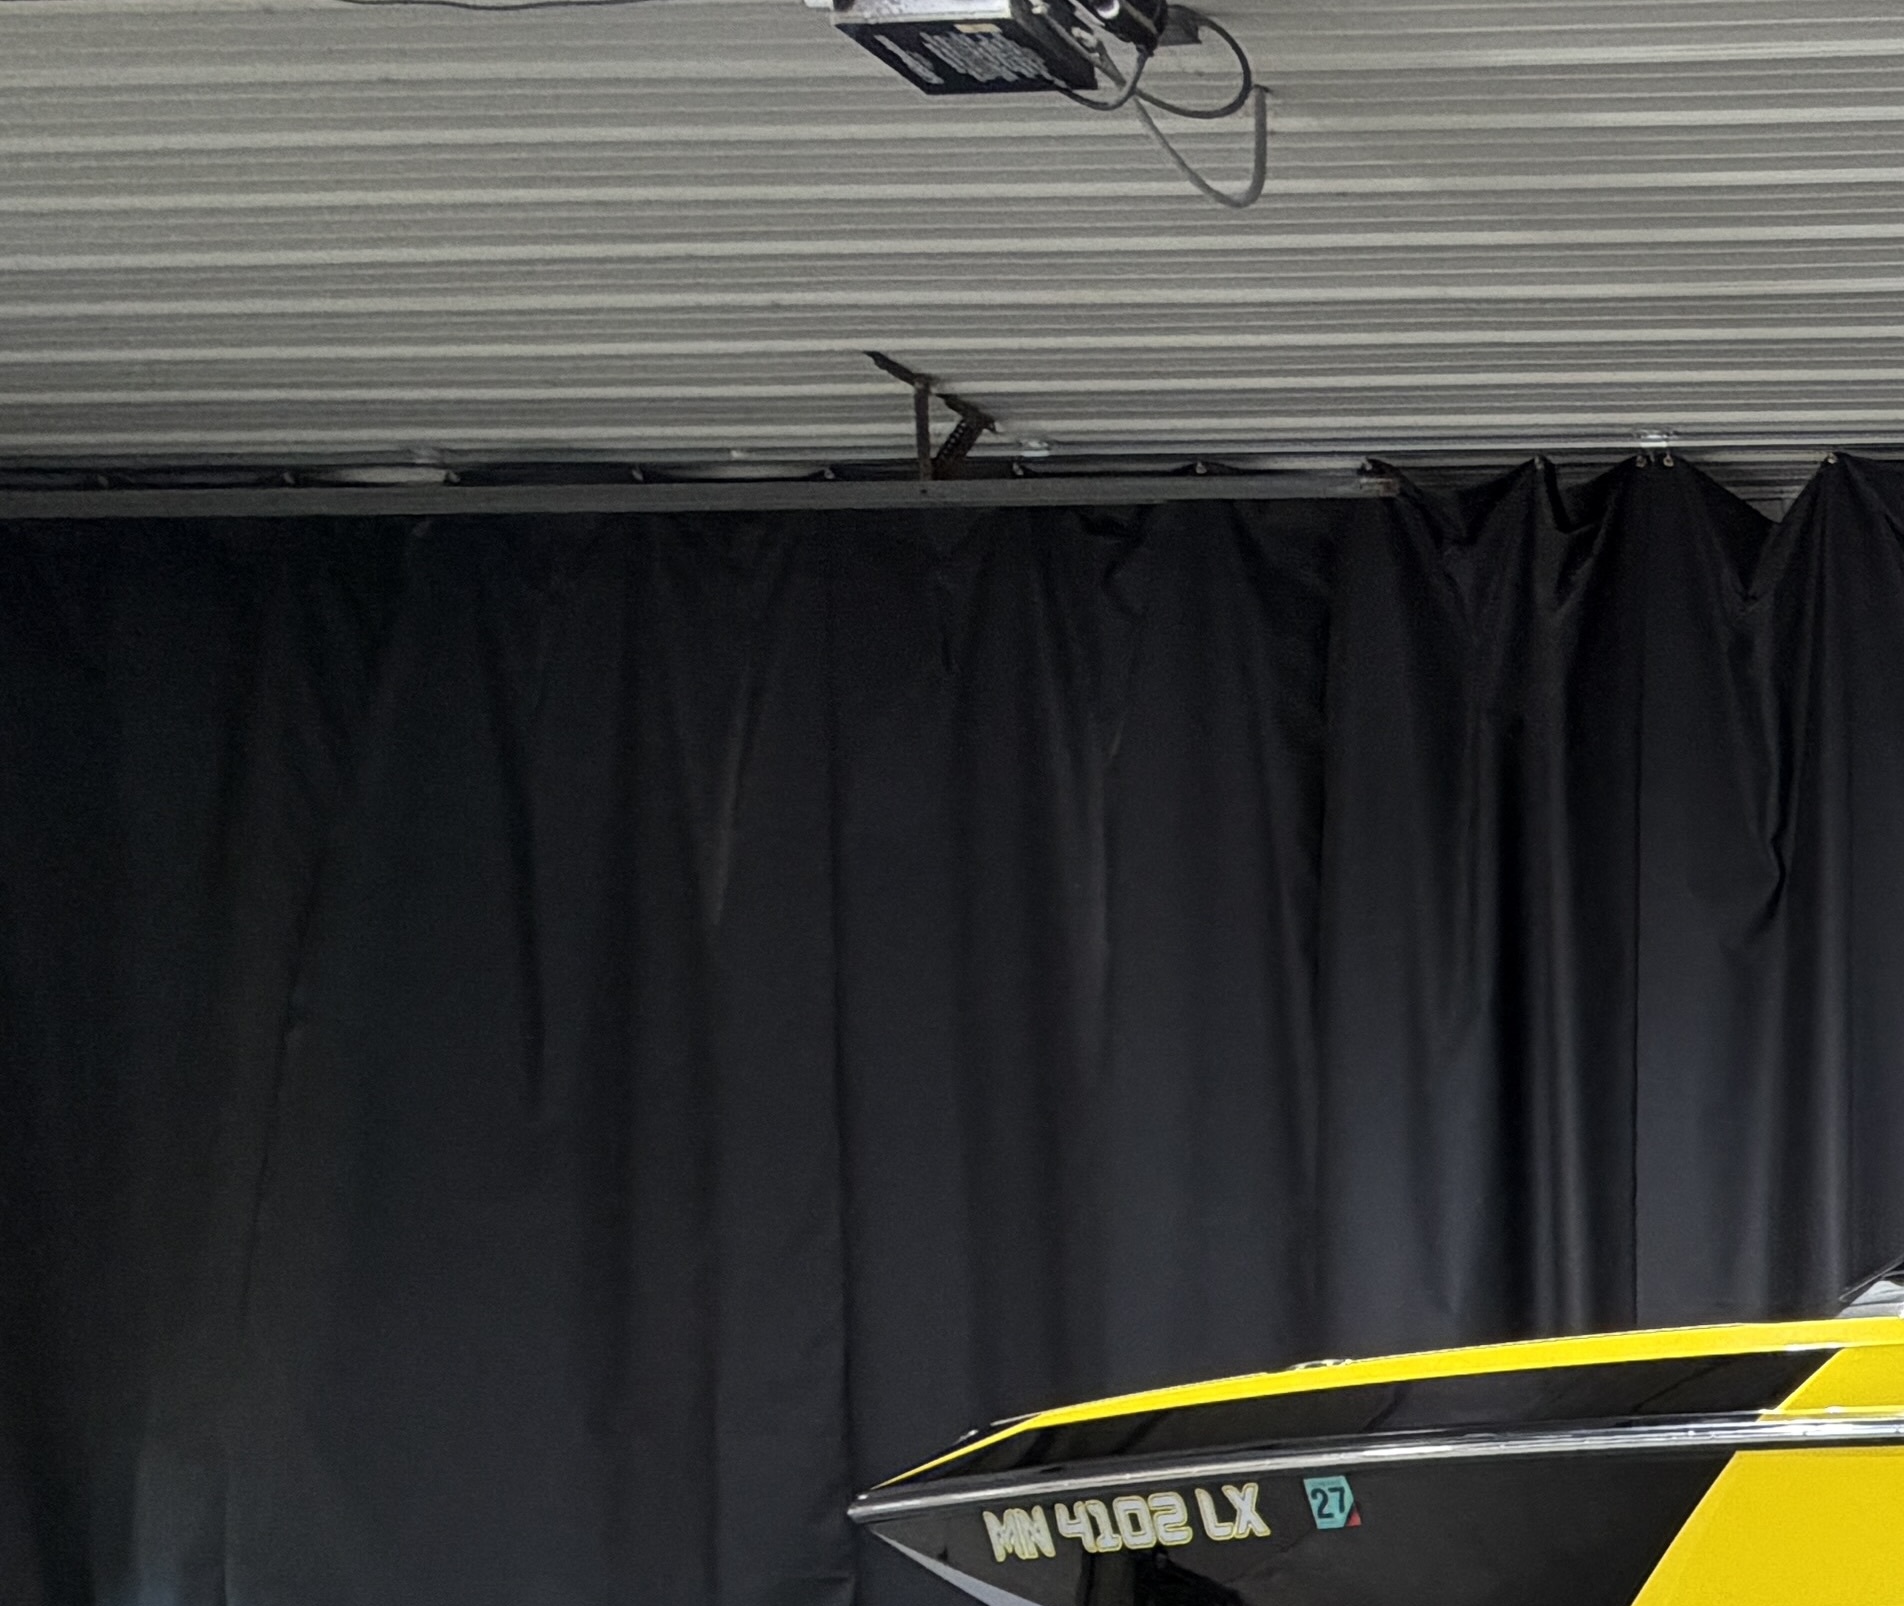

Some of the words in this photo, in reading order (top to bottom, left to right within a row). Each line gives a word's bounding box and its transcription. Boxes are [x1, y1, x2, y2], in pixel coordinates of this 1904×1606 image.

[982, 1504, 1056, 1562] MN
[1054, 1491, 1193, 1553] 4102
[1195, 1482, 1271, 1541] LX
[1310, 1486, 1346, 1519] 27
